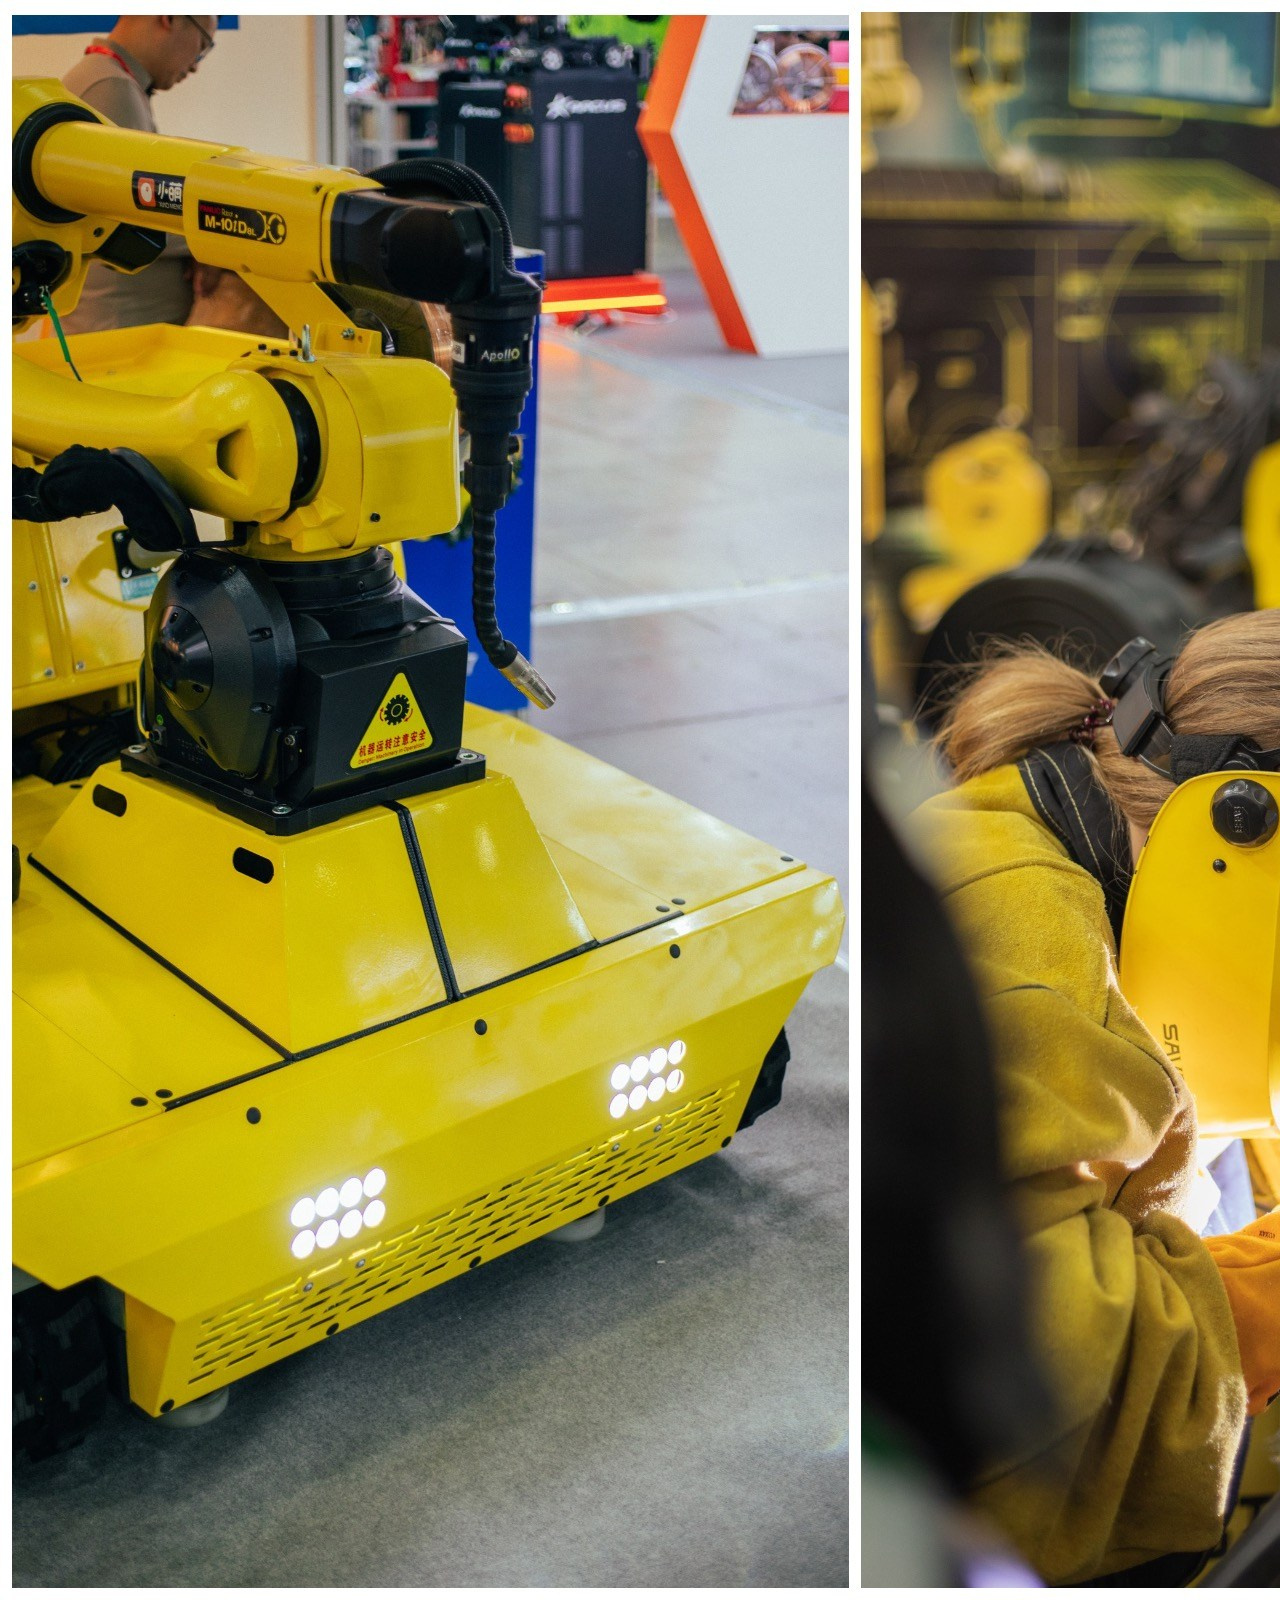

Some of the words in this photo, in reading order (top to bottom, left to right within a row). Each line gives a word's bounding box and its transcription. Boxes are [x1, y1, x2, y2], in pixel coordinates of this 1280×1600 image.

[359, 729, 426, 757] 机器运转注意安全
